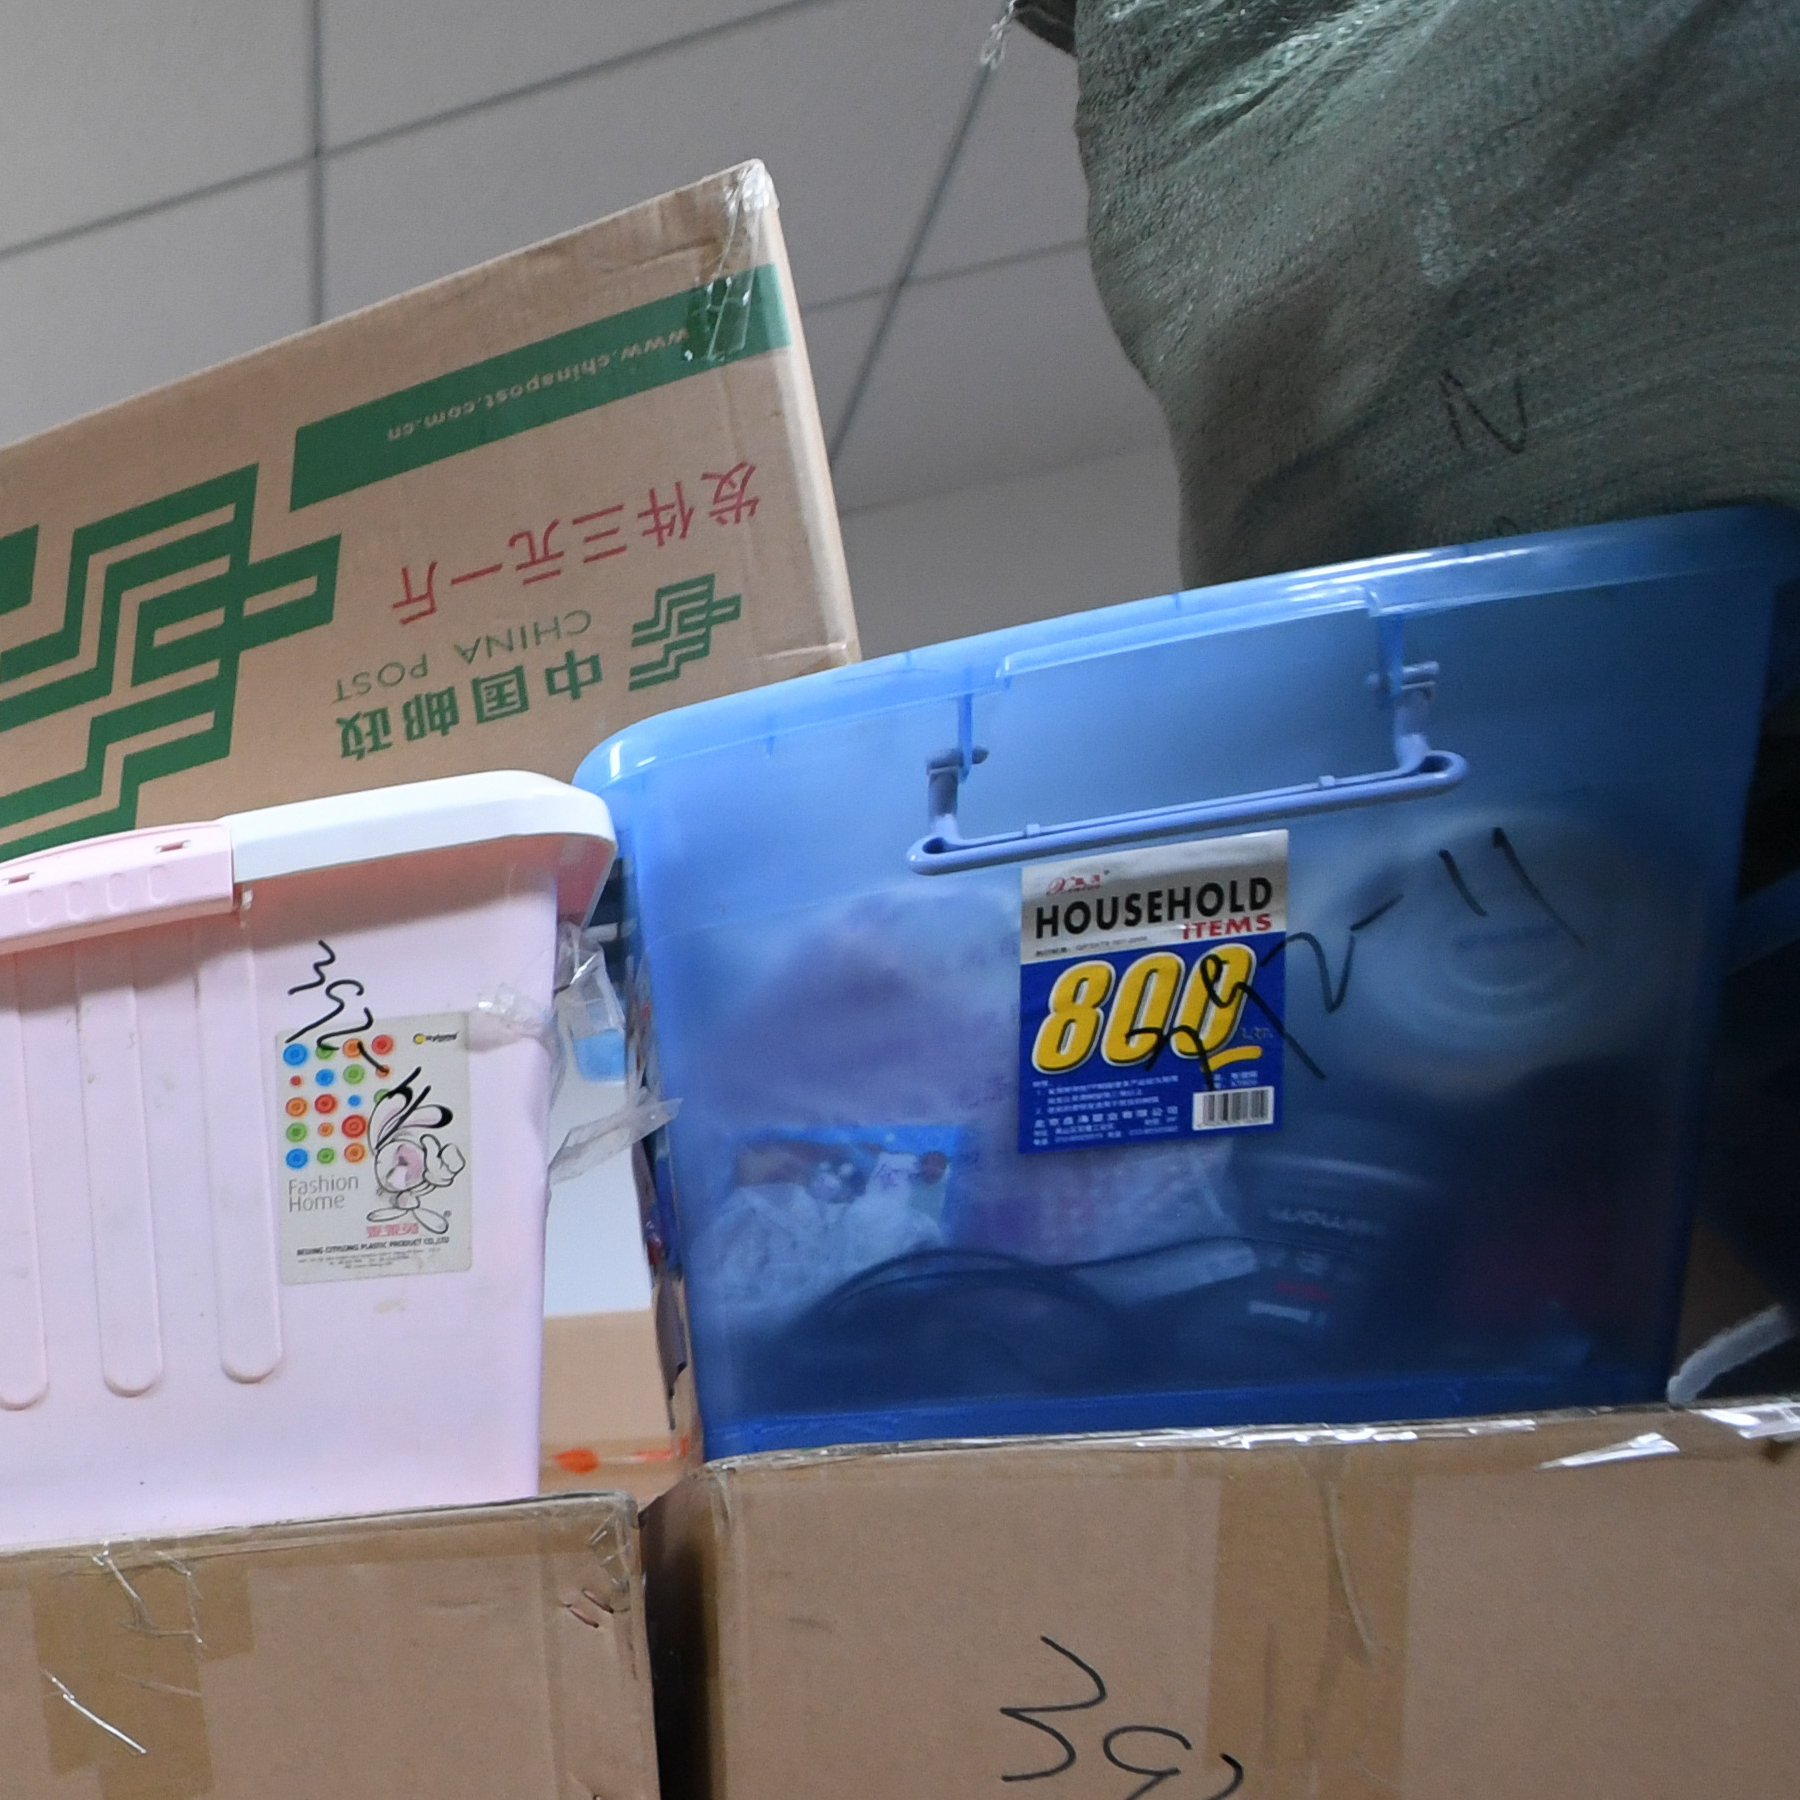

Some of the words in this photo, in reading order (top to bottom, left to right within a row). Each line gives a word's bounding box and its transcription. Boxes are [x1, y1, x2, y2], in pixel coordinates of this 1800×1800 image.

[386, 322, 690, 444] www.chinapost.com.cn
[390, 461, 759, 627] 发件三元一斤
[454, 609, 592, 666] CHINA
[333, 650, 431, 708] POST
[333, 646, 603, 762] 中国邮政
[1035, 876, 1273, 940] HOUSEHOLD
[1031, 942, 1257, 1075] 800
[288, 1174, 360, 1197] Fashion
[288, 1194, 346, 1214] Home
